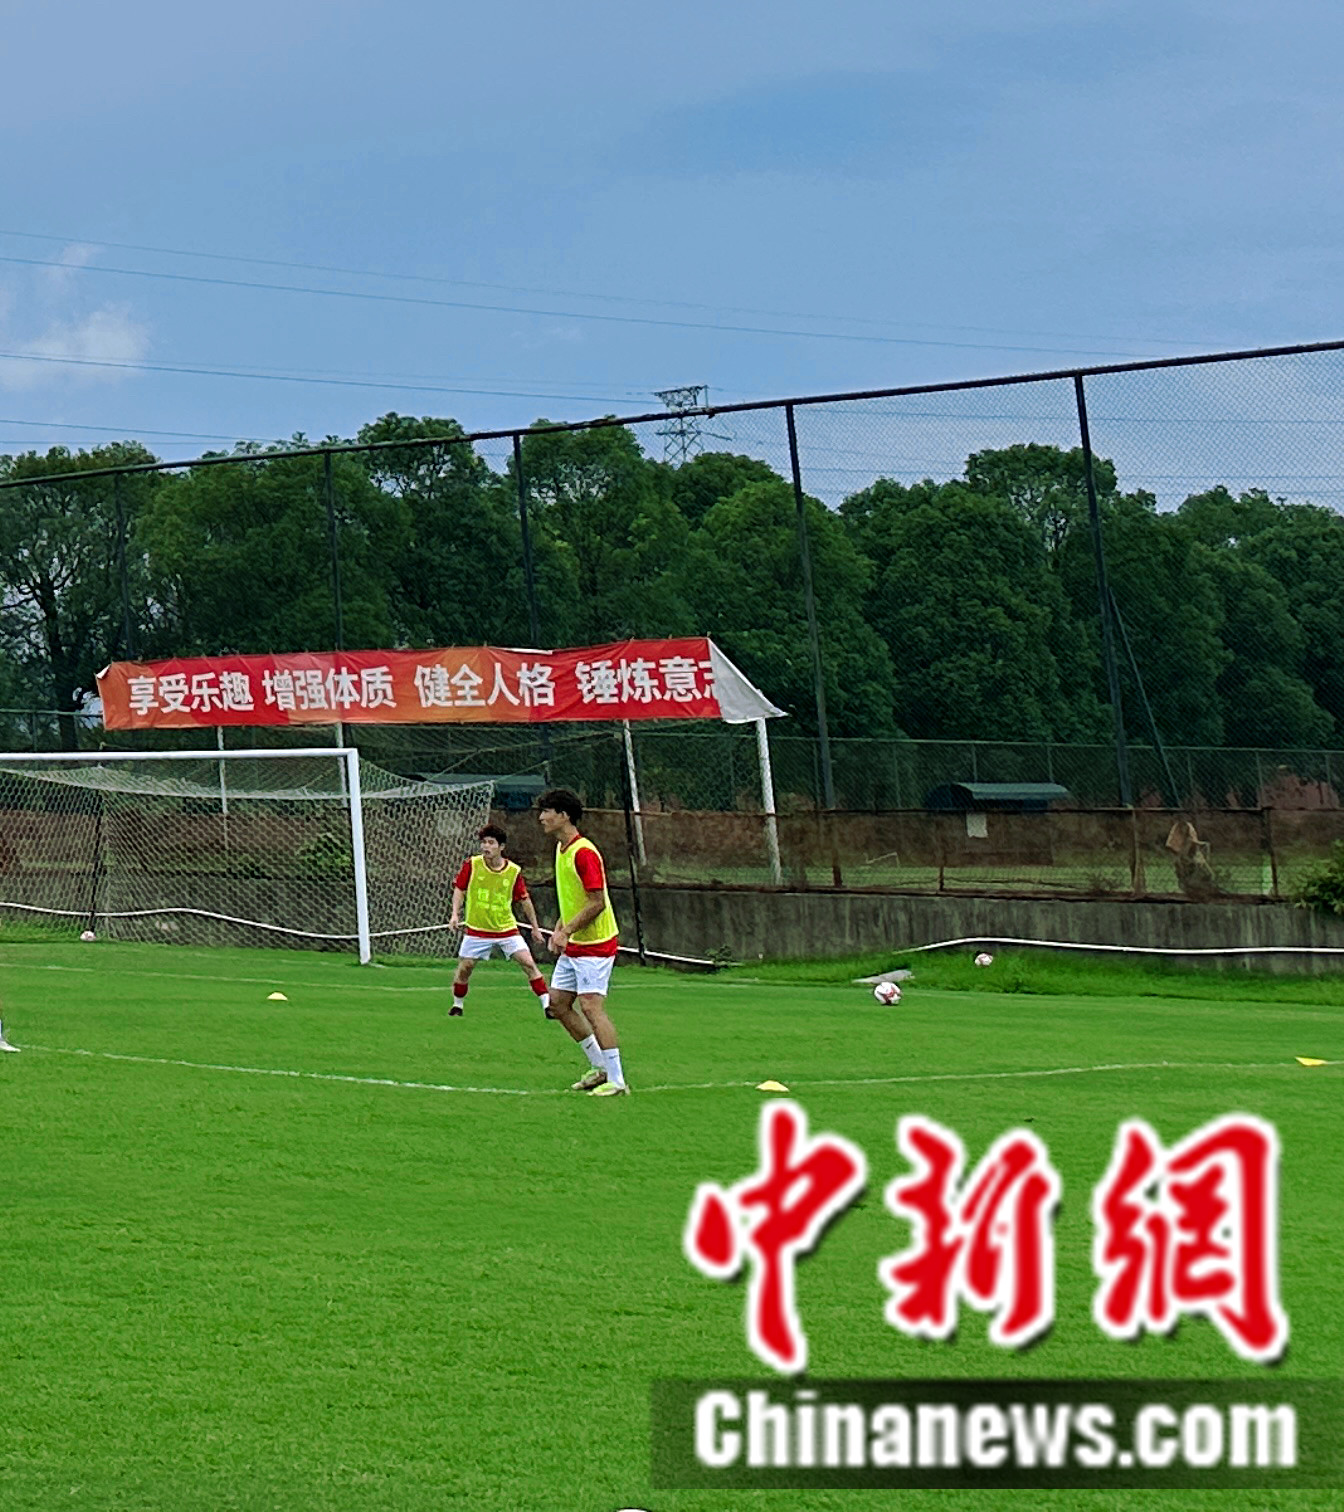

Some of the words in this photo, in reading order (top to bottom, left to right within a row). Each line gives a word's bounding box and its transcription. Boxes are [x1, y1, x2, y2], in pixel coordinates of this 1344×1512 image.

[127, 671, 255, 716] 享受乐趣
[262, 665, 397, 711] 增强体质
[413, 662, 556, 708] 健全人格
